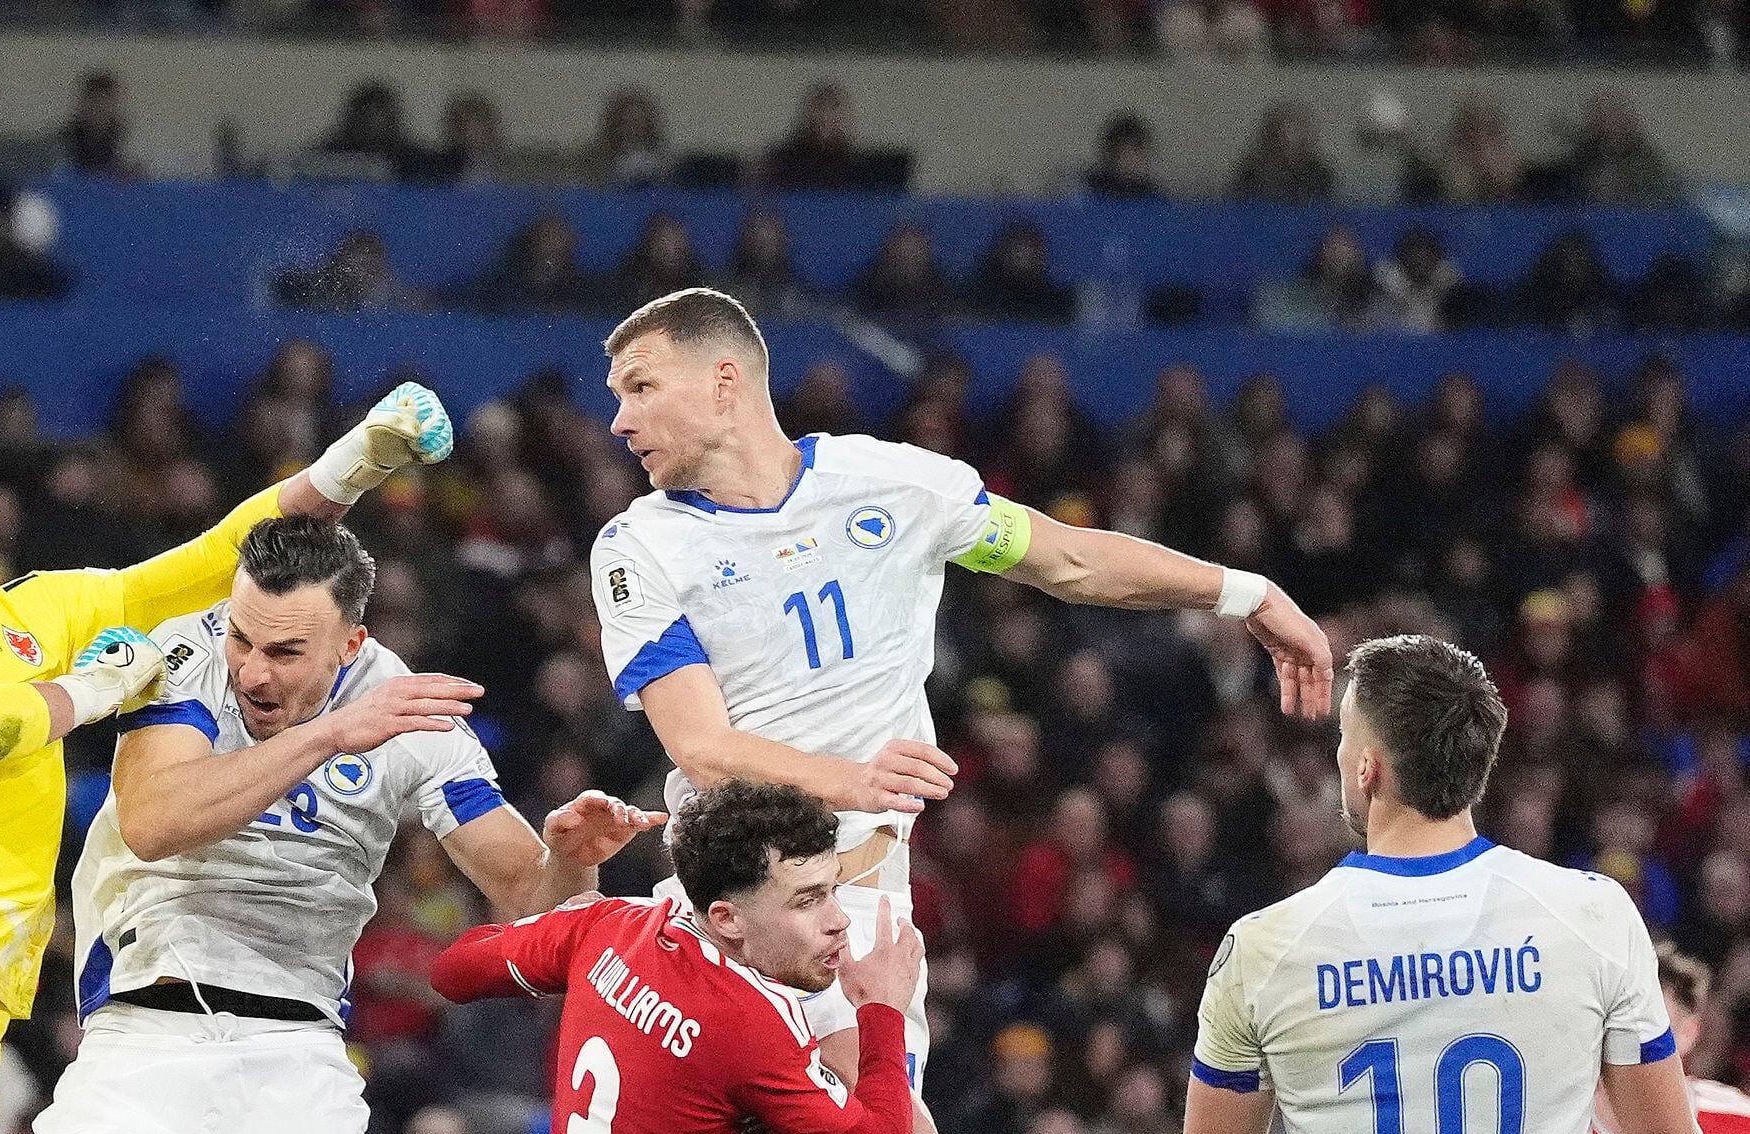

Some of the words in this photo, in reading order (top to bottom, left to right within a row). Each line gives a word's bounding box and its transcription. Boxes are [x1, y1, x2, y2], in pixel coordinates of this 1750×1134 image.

[989, 512, 1015, 560] RESPECT
[713, 574, 752, 590] KELME
[783, 579, 854, 670] 11
[1316, 935, 1543, 1010] DEMIROVIĆ
